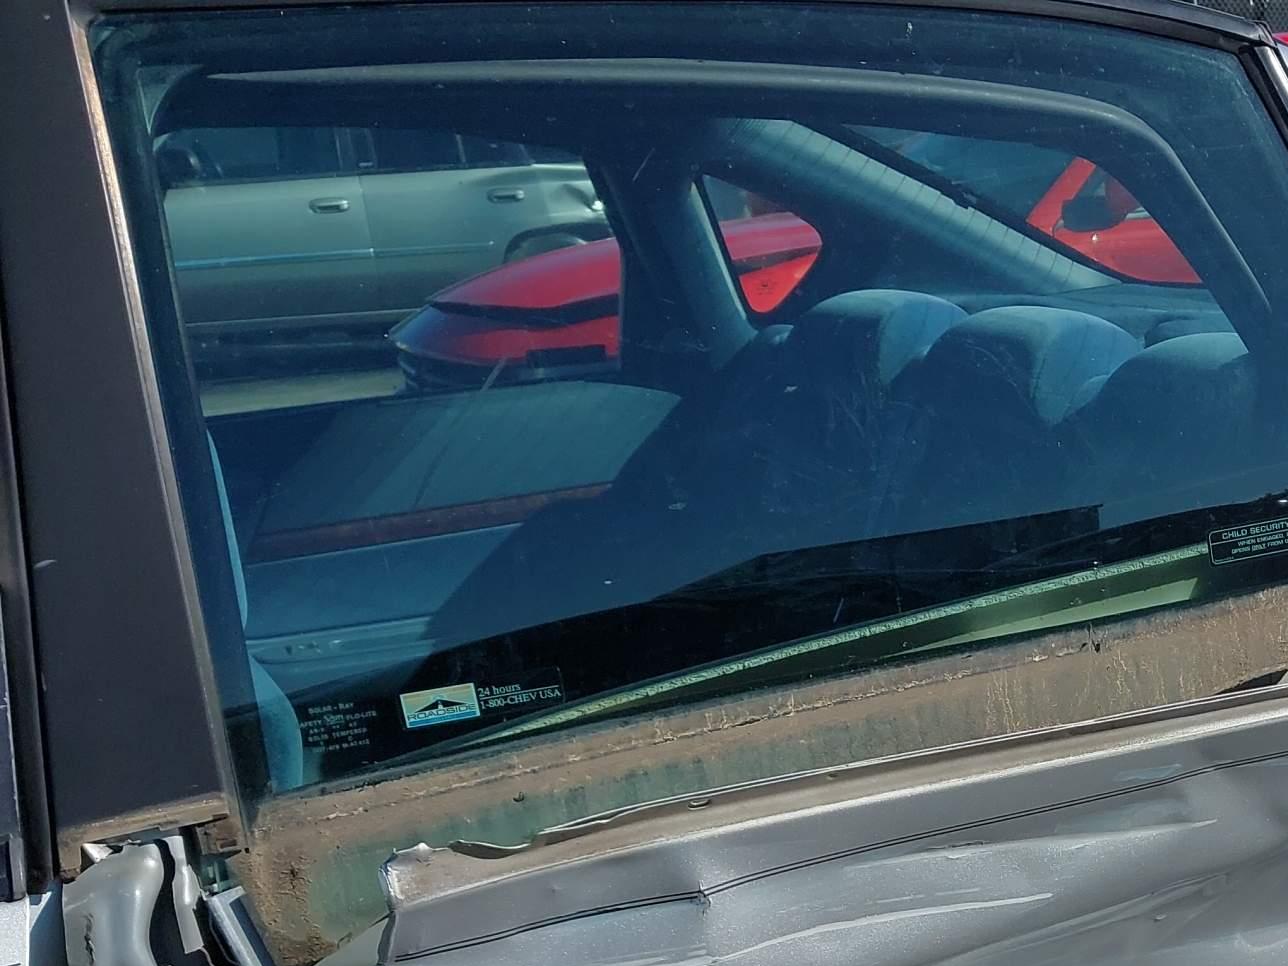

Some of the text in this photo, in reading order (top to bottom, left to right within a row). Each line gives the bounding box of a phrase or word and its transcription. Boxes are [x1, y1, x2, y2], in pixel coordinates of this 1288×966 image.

[1222, 528, 1248, 540] CHILD
[1231, 546, 1251, 554] OPENS
[1267, 540, 1284, 548] FROM
[1237, 537, 1256, 546] WHEN
[478, 684, 521, 698] 24 hours
[480, 688, 562, 710] 1-800-CHEV USA
[407, 703, 476, 722] ROADSIDE
